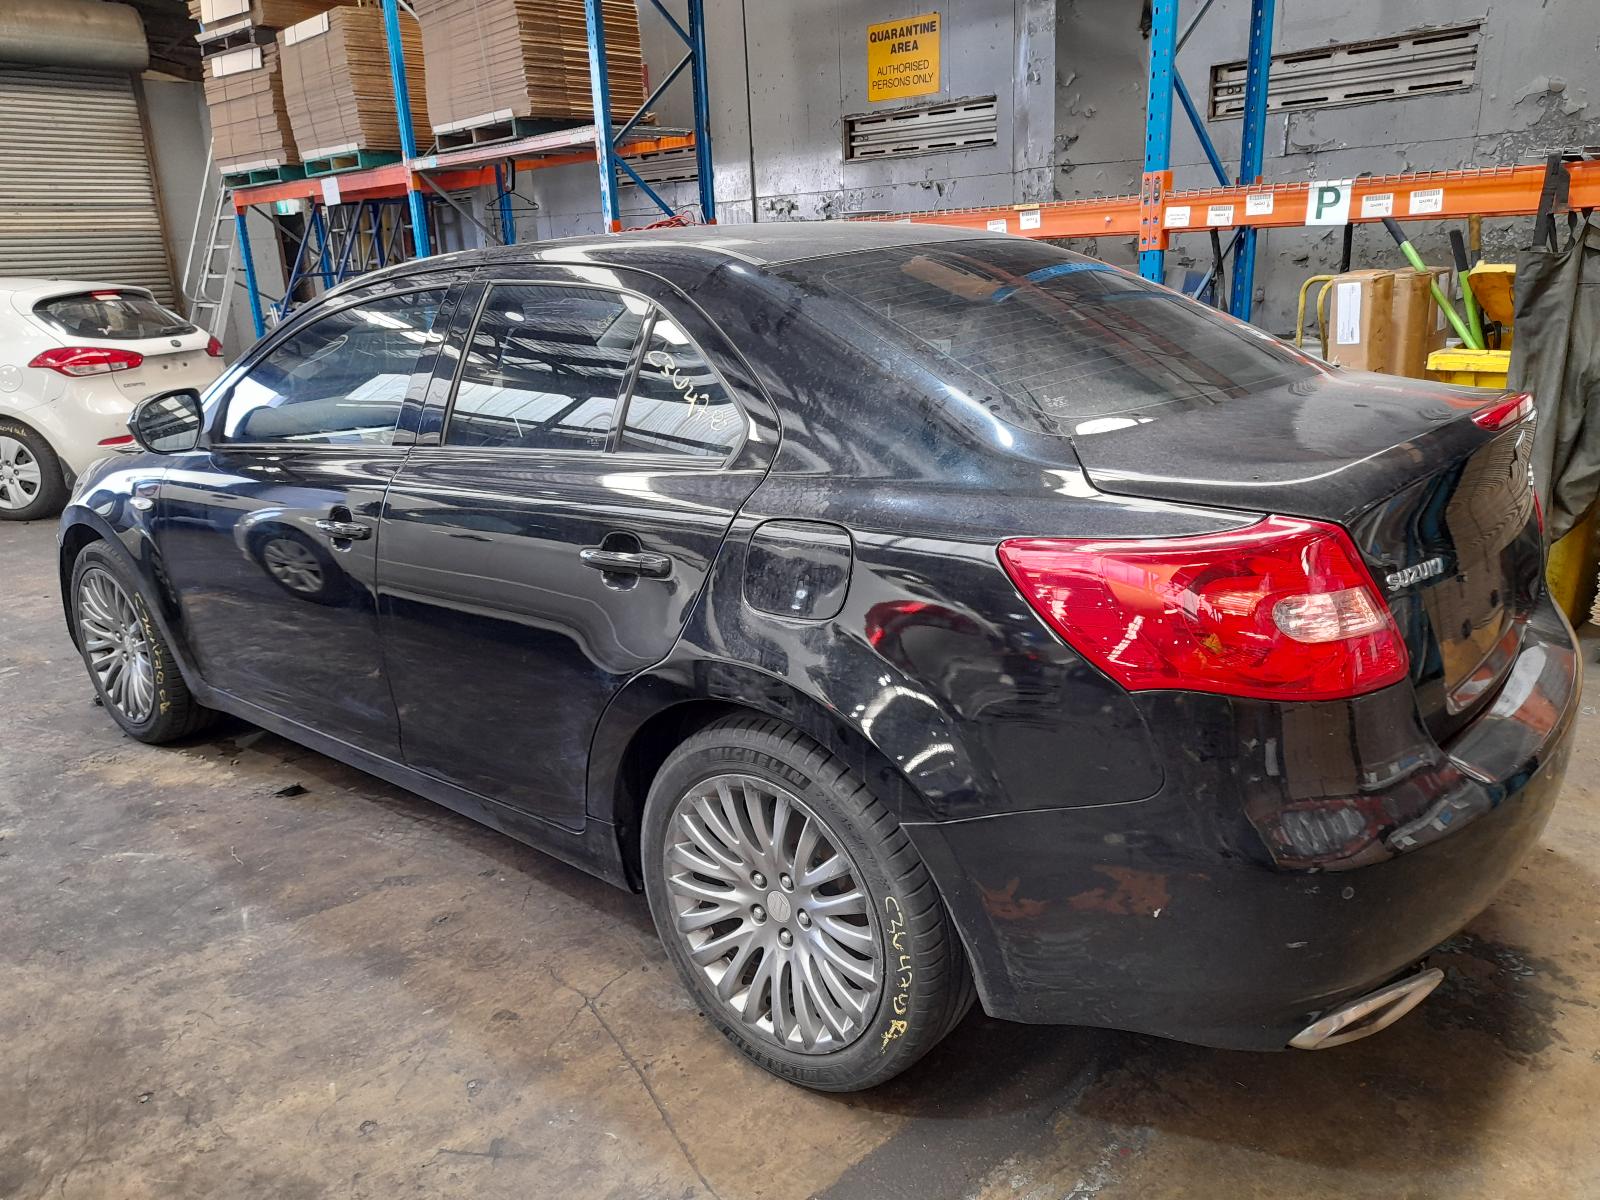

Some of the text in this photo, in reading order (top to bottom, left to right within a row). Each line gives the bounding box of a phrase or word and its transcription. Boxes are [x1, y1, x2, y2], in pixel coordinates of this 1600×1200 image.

[870, 21, 937, 43] QUARANTINE
[890, 40, 919, 55] AREA
[877, 60, 930, 76] AUTHORISED
[872, 72, 934, 90] PERSONS ONLY
[1315, 186, 1341, 220] P
